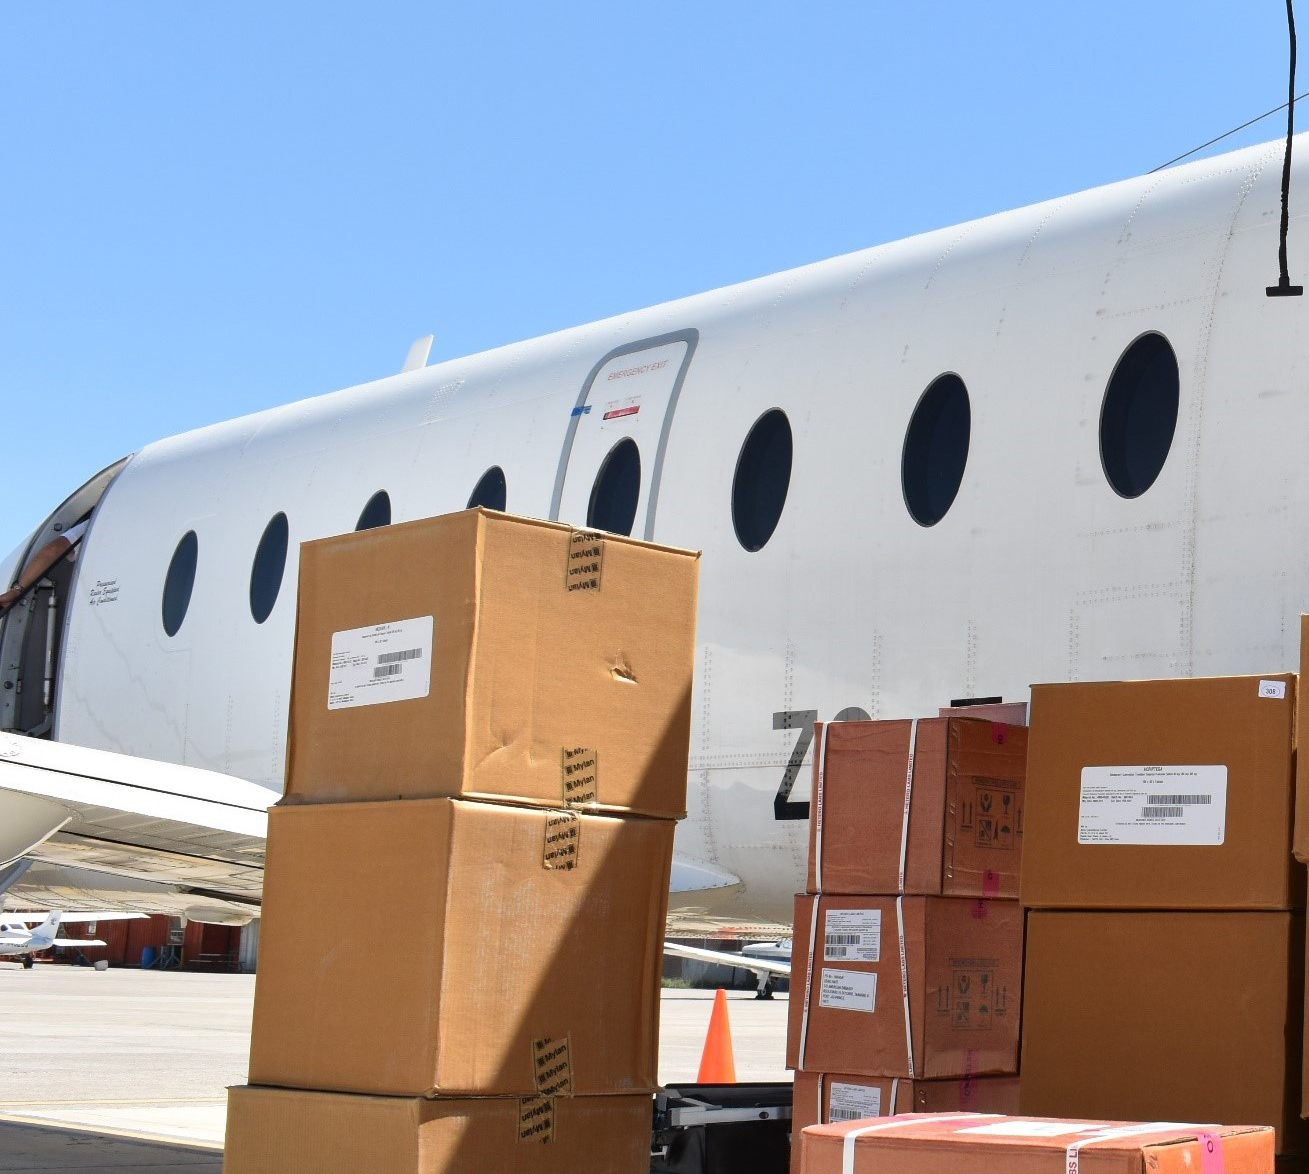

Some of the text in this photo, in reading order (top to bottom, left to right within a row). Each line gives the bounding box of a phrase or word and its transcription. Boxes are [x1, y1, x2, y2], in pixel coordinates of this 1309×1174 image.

[607, 359, 669, 381] EMERGENCY EXIT
[570, 549, 593, 559] Mylan
[569, 565, 591, 576] Mylan
[573, 759, 595, 772] Mylan
[573, 775, 595, 788] Mylan
[573, 791, 595, 804] Mylan
[547, 831, 569, 844] Mylan
[545, 847, 568, 860] Mylan
[545, 1045, 567, 1062] Mylan
[545, 1061, 568, 1079] Mylan
[522, 1107, 544, 1122] Mylan
[520, 1124, 544, 1139] Mylan
